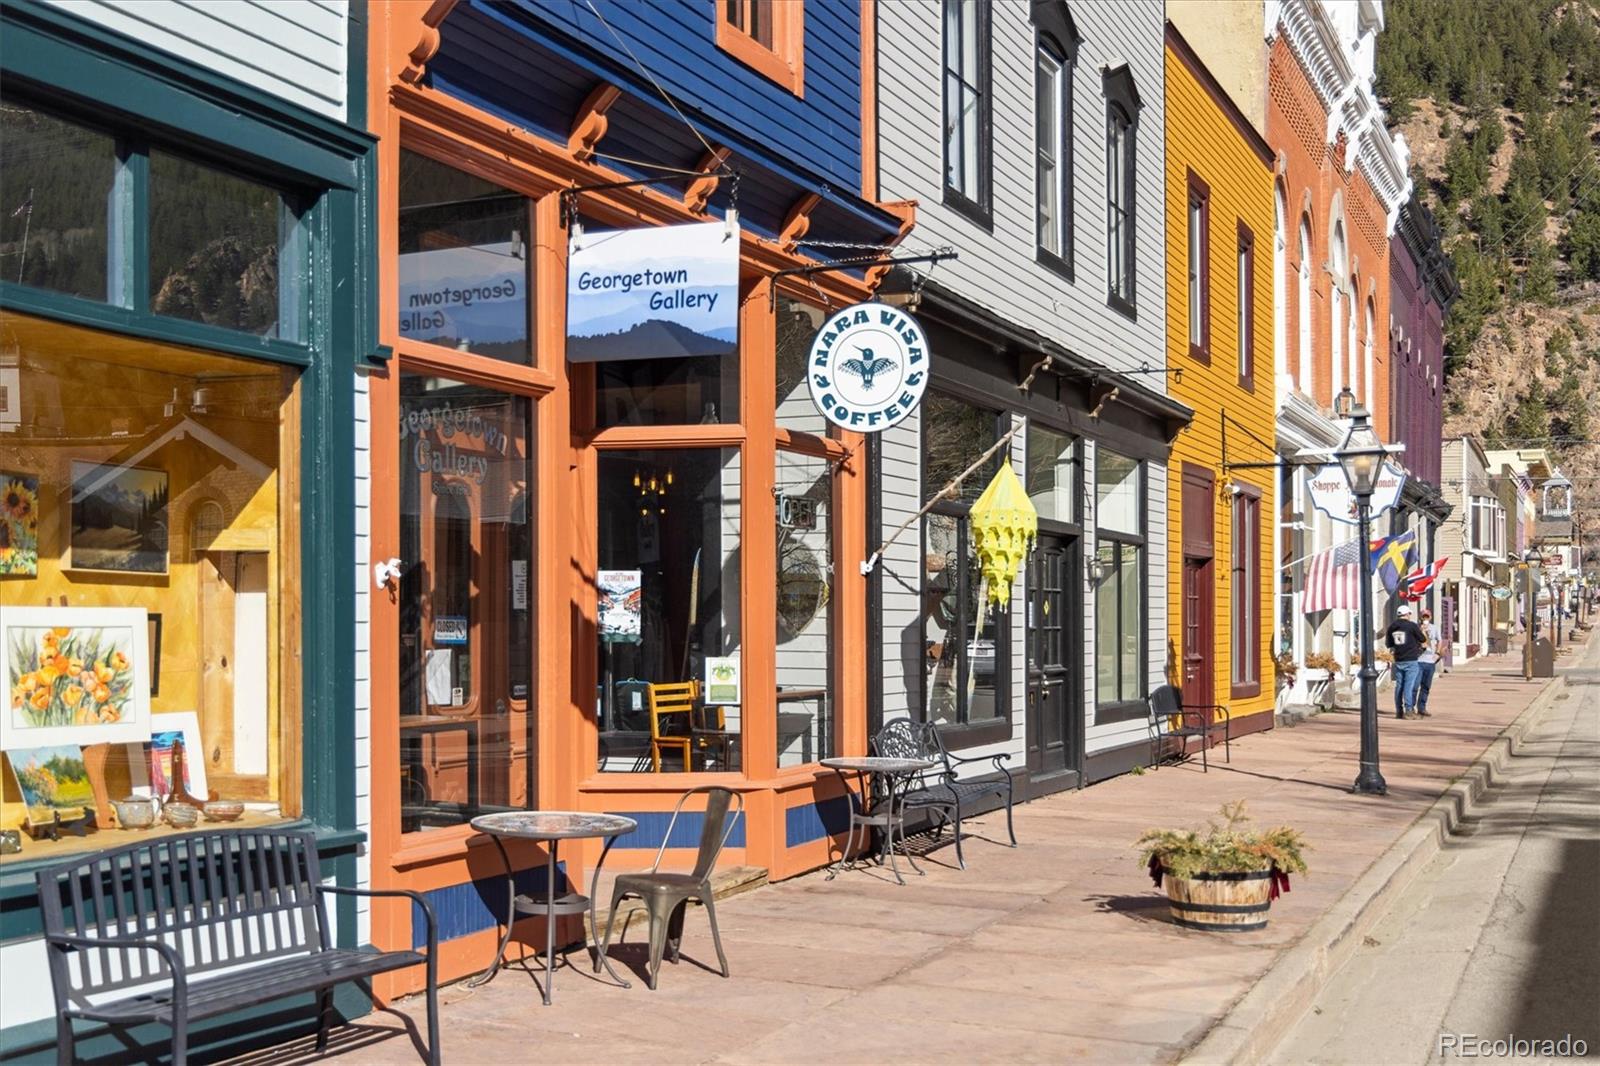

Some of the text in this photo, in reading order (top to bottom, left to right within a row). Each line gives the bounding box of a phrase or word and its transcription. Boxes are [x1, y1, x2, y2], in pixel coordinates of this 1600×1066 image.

[578, 269, 688, 293] Georgetown
[649, 289, 719, 313] Gallery
[814, 309, 923, 368] NARA VISA
[821, 390, 916, 427] COFFEE
[414, 438, 488, 485] Gallery
